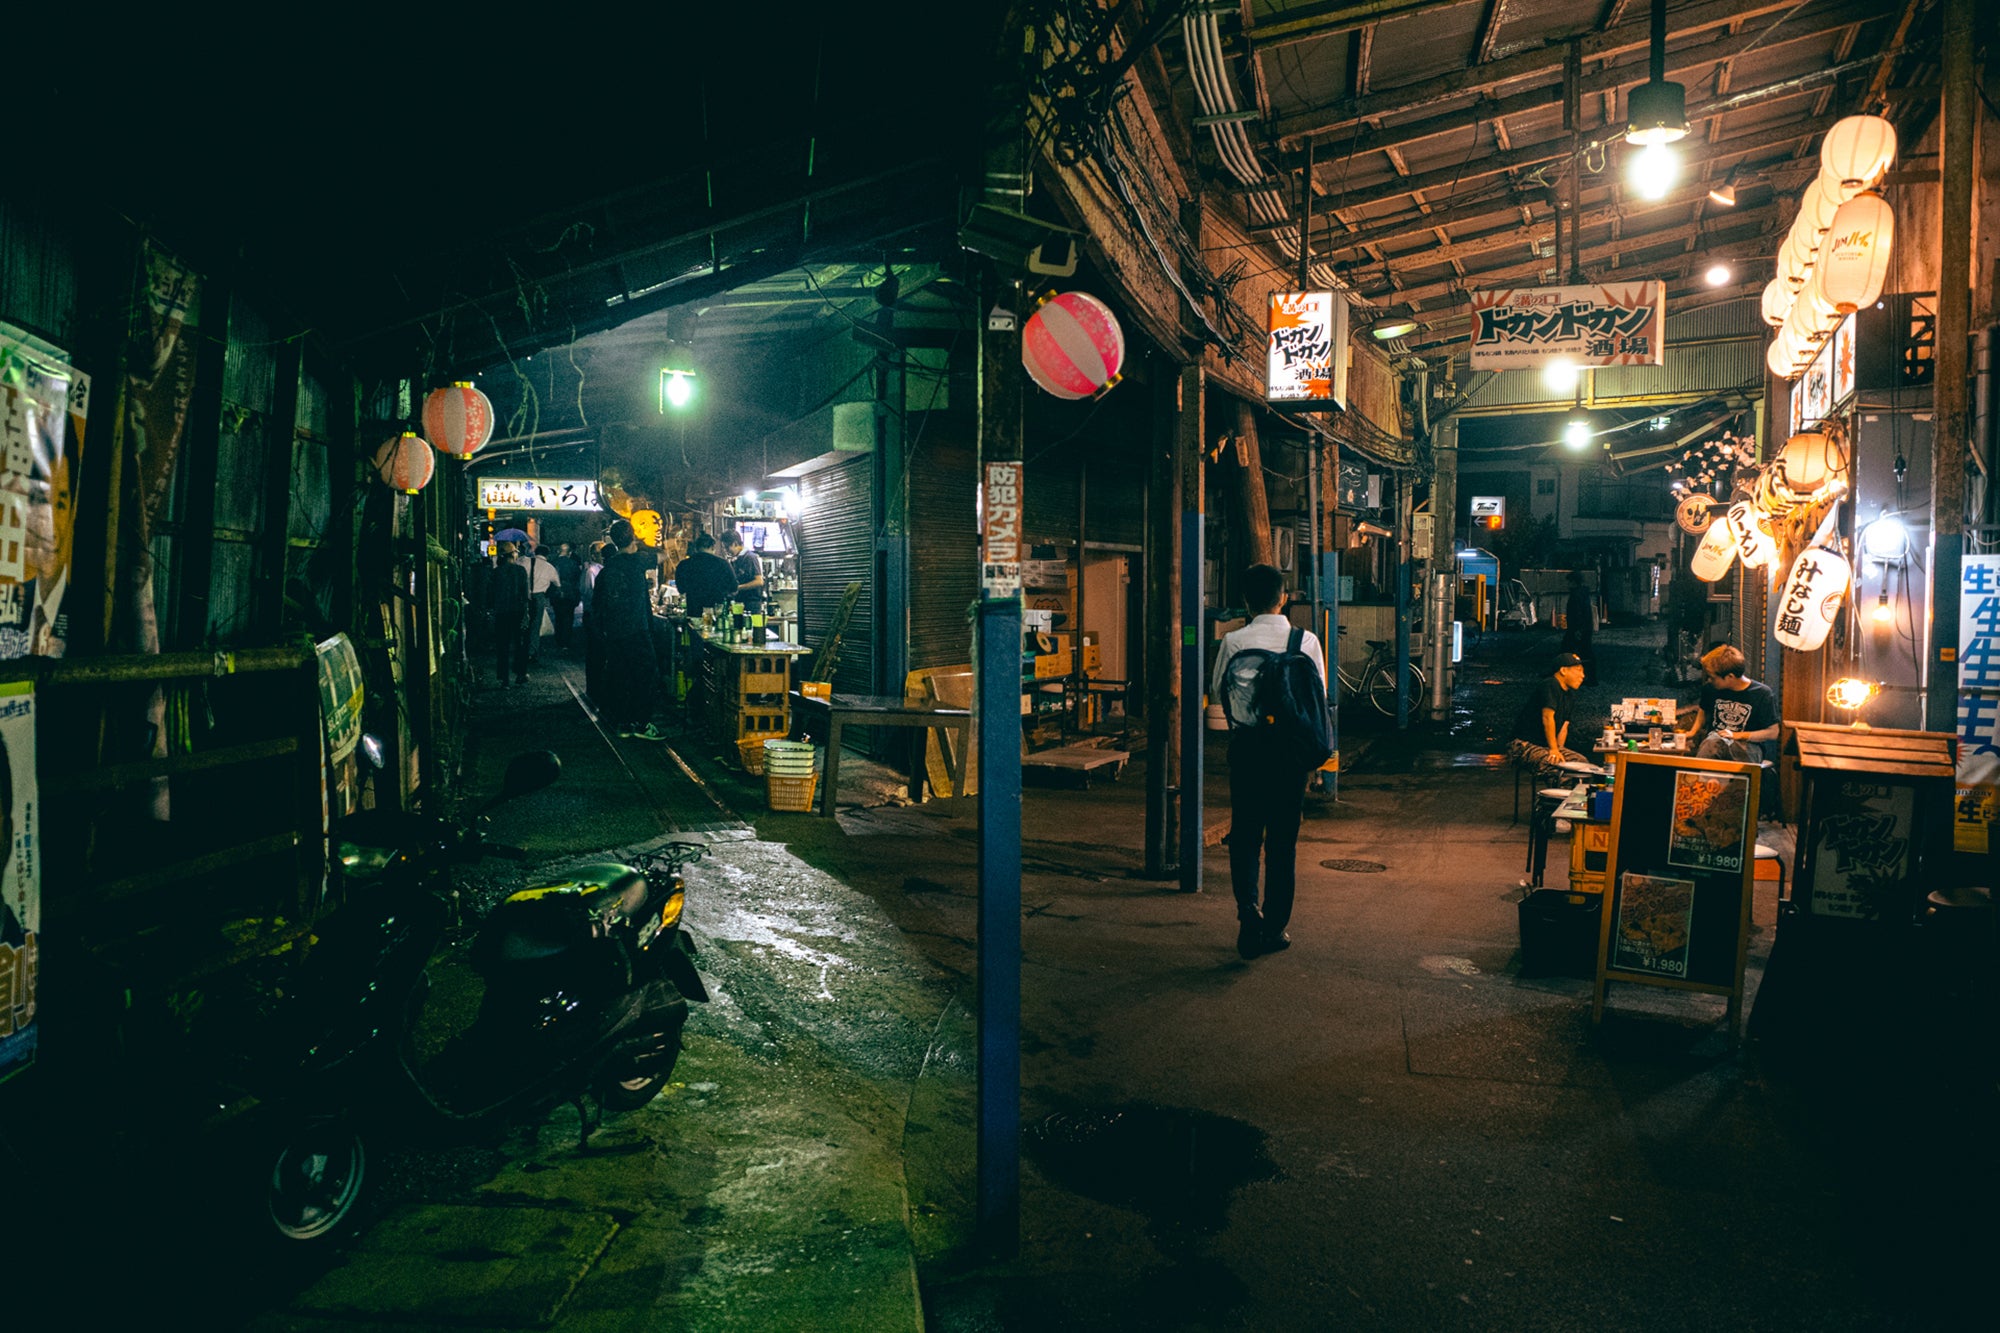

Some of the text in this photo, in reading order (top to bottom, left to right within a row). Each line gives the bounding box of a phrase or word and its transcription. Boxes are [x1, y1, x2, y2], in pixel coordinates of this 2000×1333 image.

[1475, 301, 1655, 346] ドカンドカン
[1273, 324, 1323, 351] ドカン
[1585, 337, 1649, 357] 酒場
[1282, 340, 1332, 367] ドカン
[1295, 367, 1332, 380] 酒場
[988, 465, 1018, 561] 防犯カメラ
[1491, 516, 1501, 529] P
[1730, 506, 1758, 558] ラーメン
[1778, 558, 1823, 637] 汁なし麺
[1678, 778, 1720, 802] カキの
